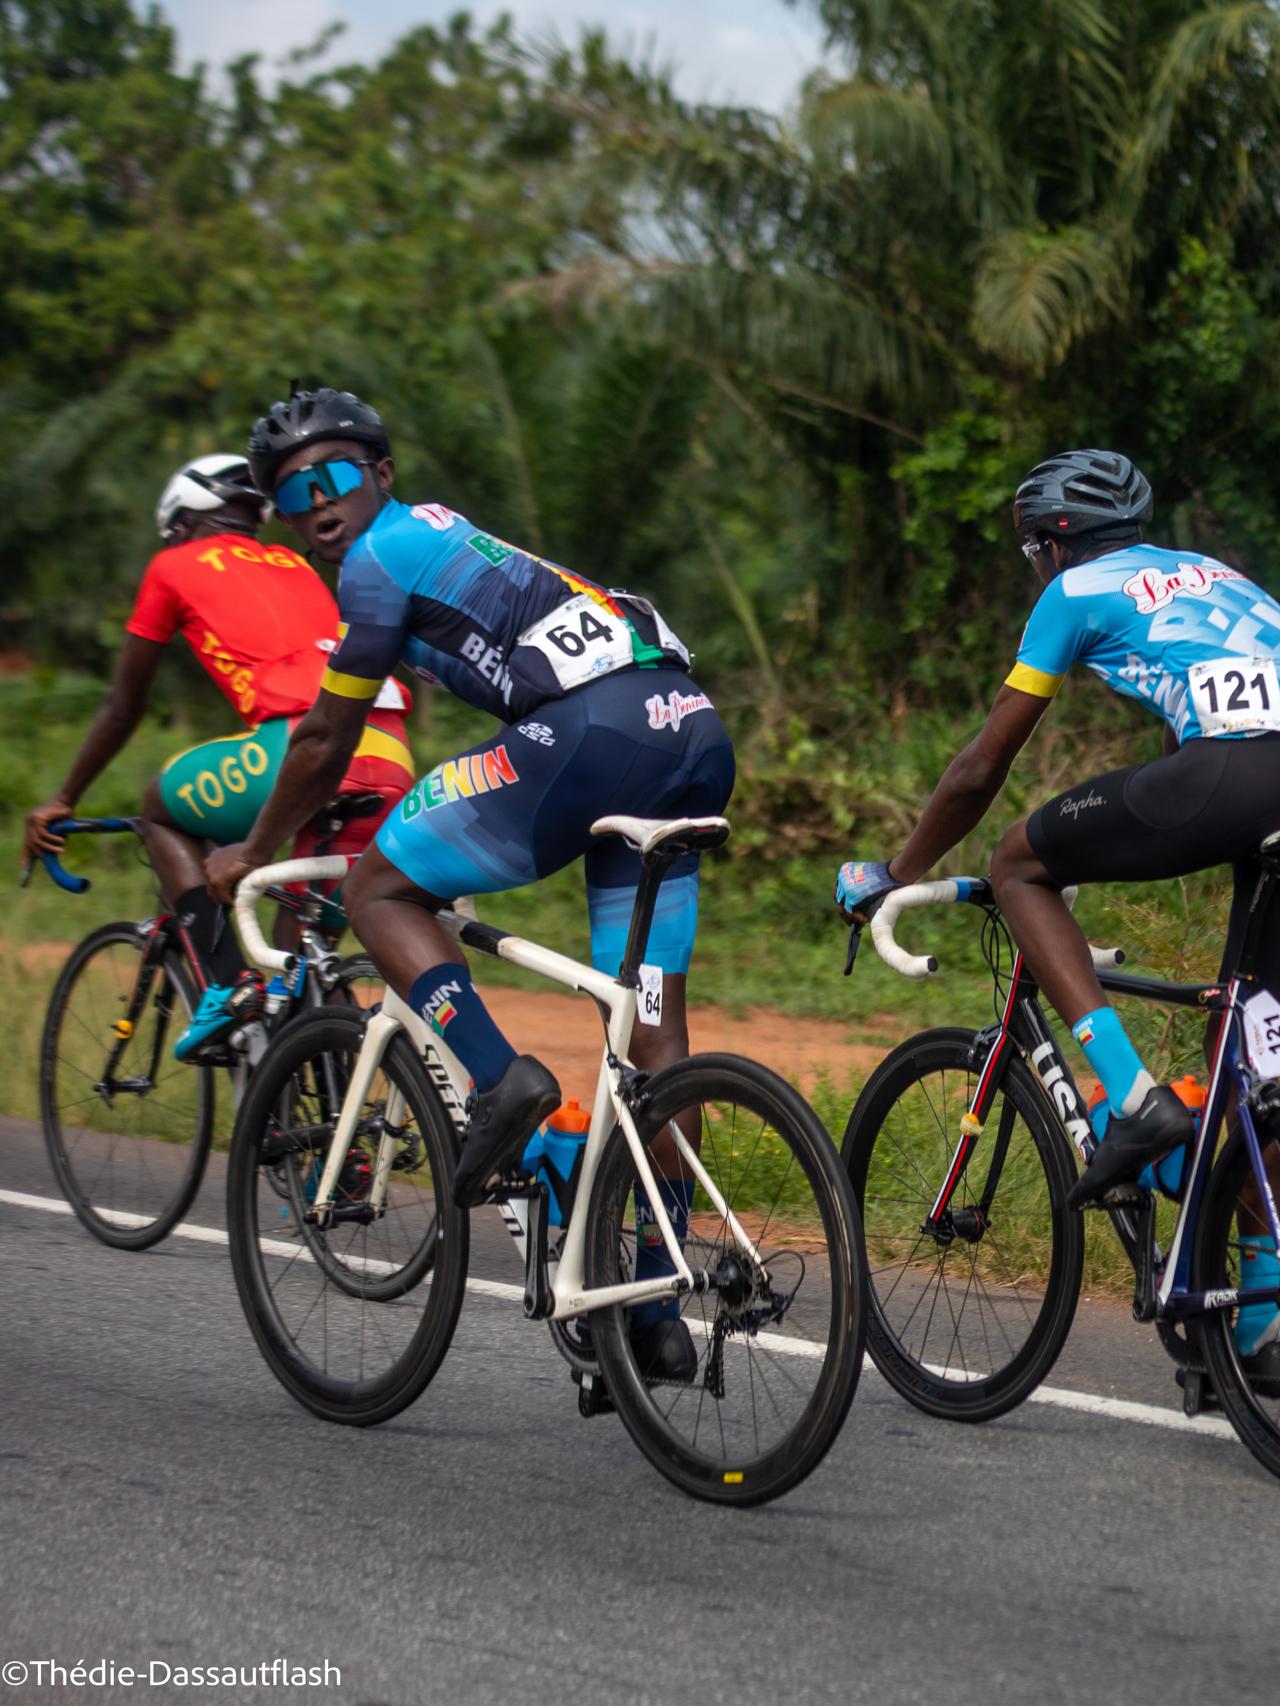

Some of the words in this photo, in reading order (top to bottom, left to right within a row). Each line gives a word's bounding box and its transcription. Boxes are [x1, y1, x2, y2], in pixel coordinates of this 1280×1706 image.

[546, 611, 614, 657] 64
[201, 630, 256, 713] TOGO
[1199, 670, 1270, 714] 121
[177, 742, 268, 819] TOGO
[402, 744, 519, 824] BENIN
[645, 991, 661, 1017] 64
